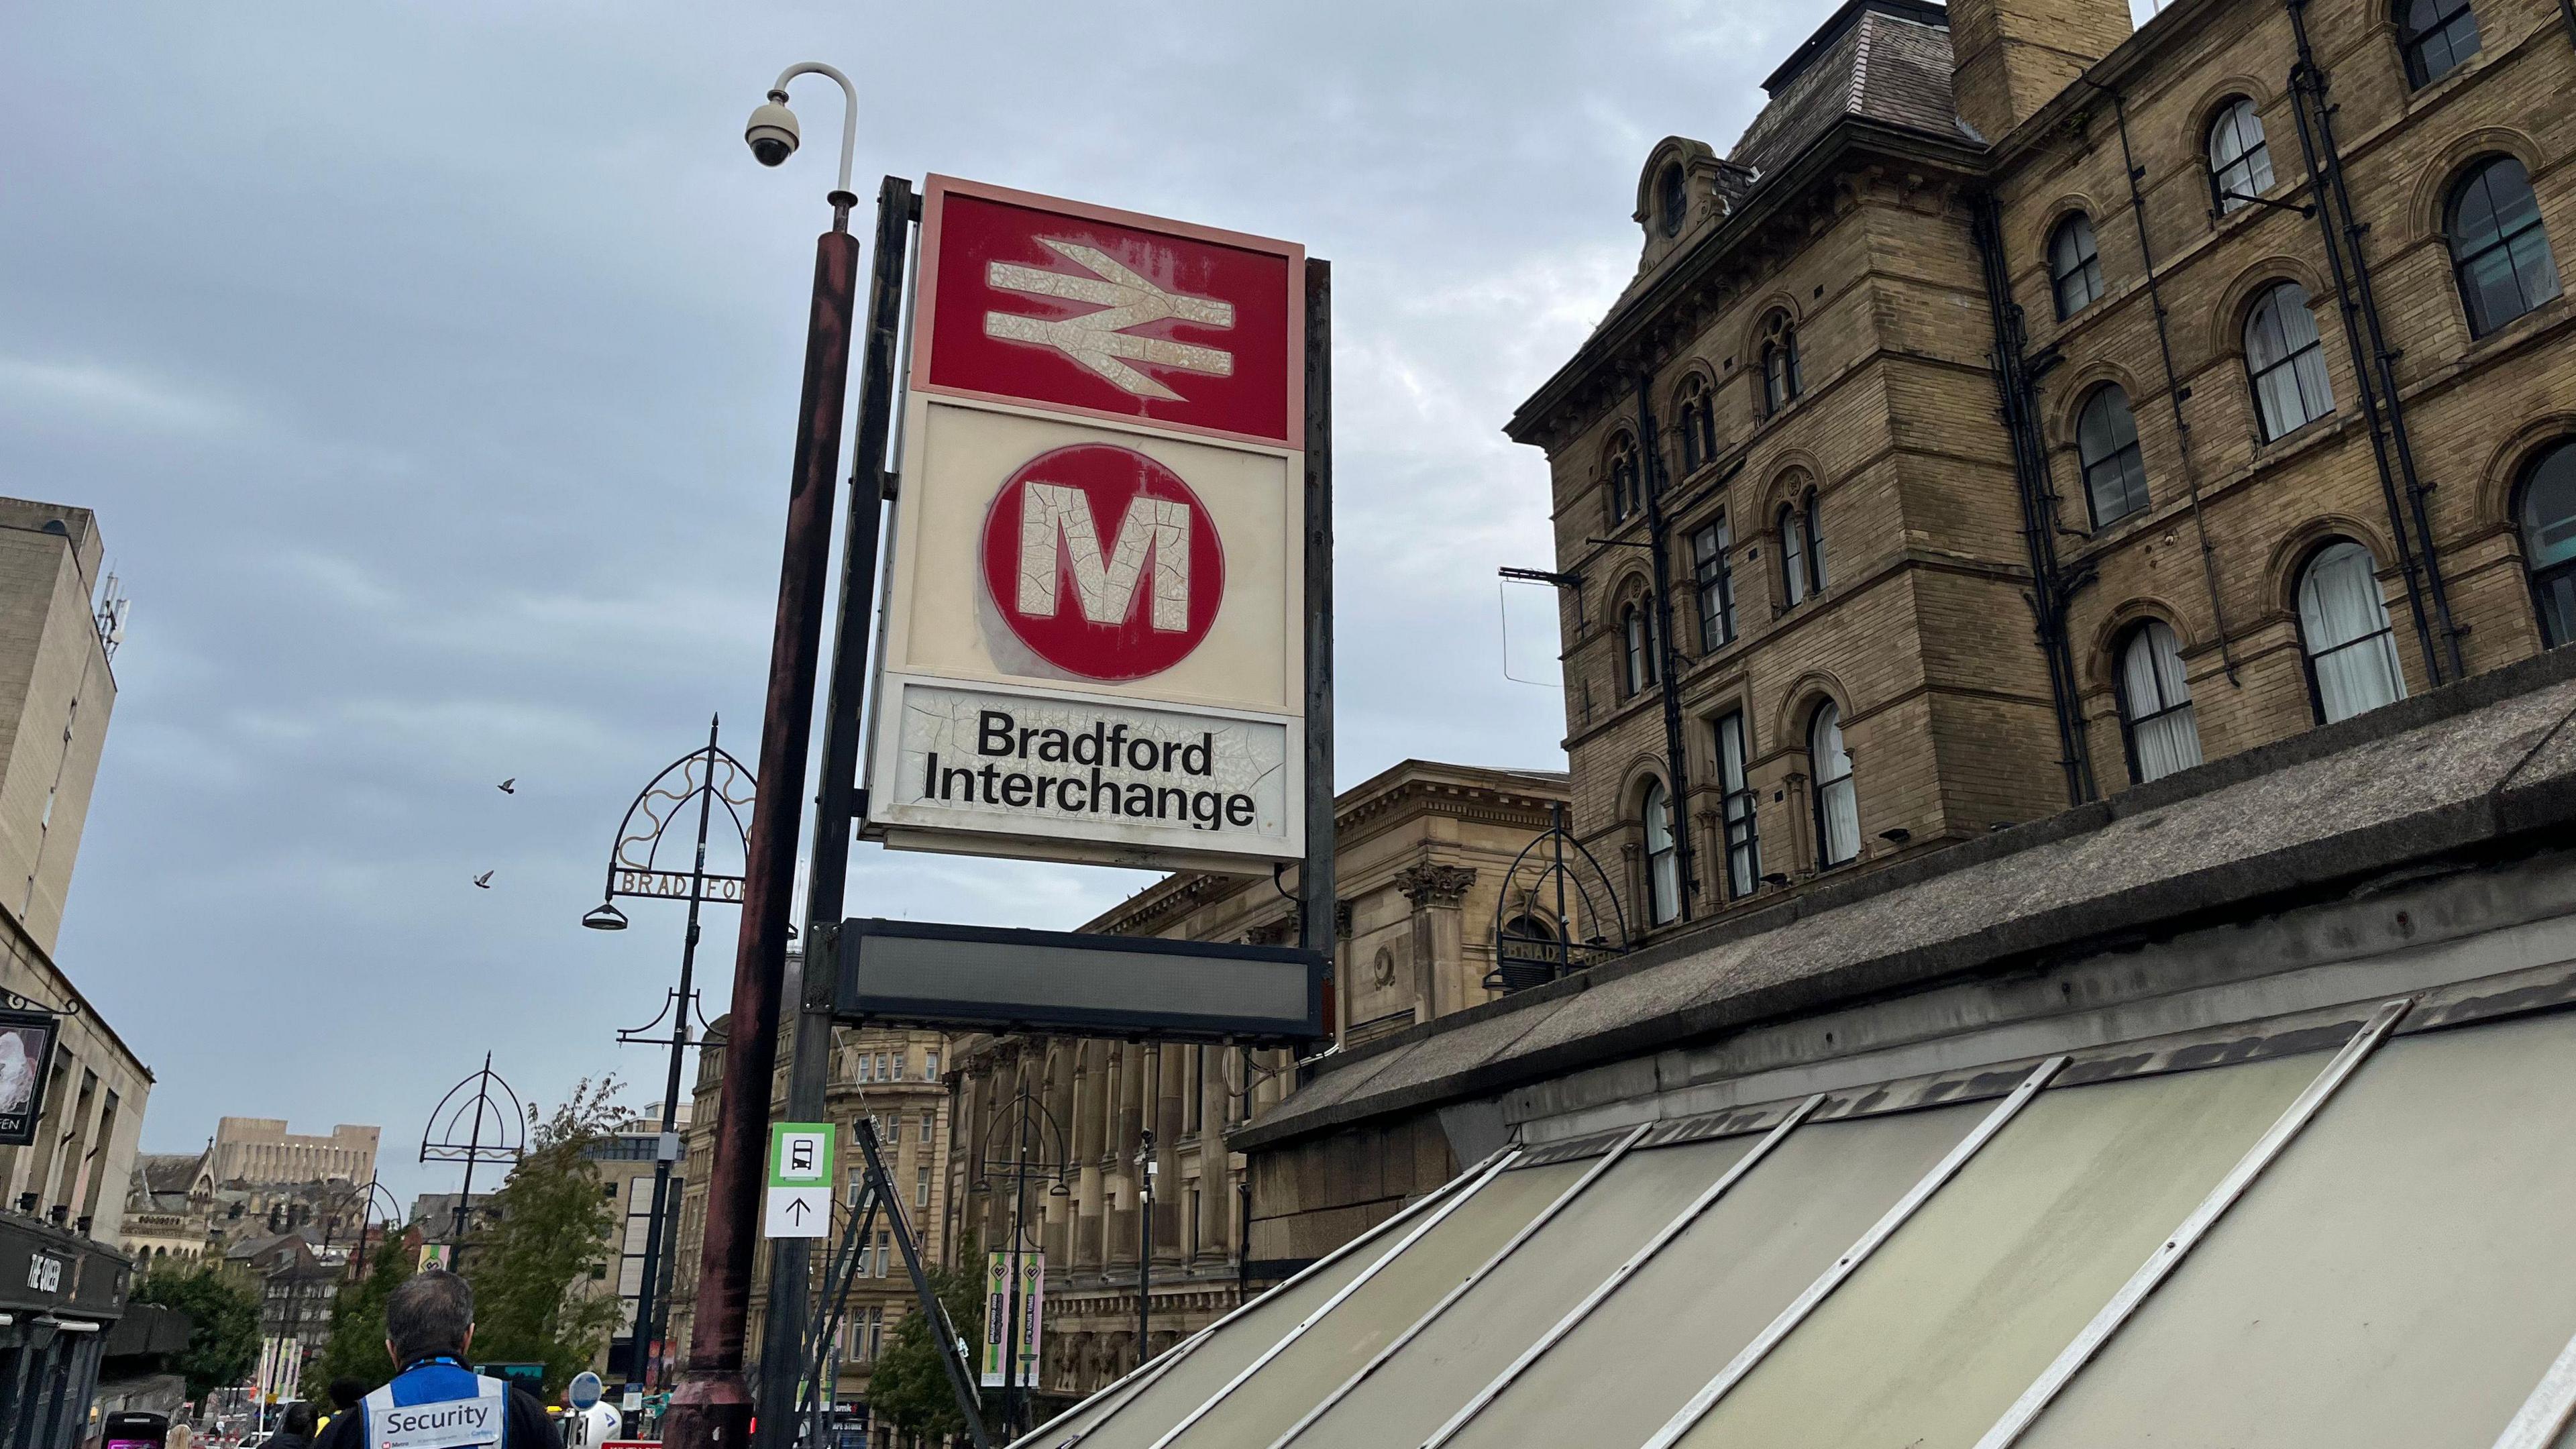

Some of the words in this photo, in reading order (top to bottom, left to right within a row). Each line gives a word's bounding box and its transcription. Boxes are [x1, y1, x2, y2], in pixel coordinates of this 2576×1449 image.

[1018, 481, 1190, 632] M
[977, 710, 1212, 776] Bradford
[924, 752, 1255, 830] Interchange
[622, 871, 686, 896] BRAD
[706, 878, 746, 901] FO
[386, 1405, 488, 1434] Security
